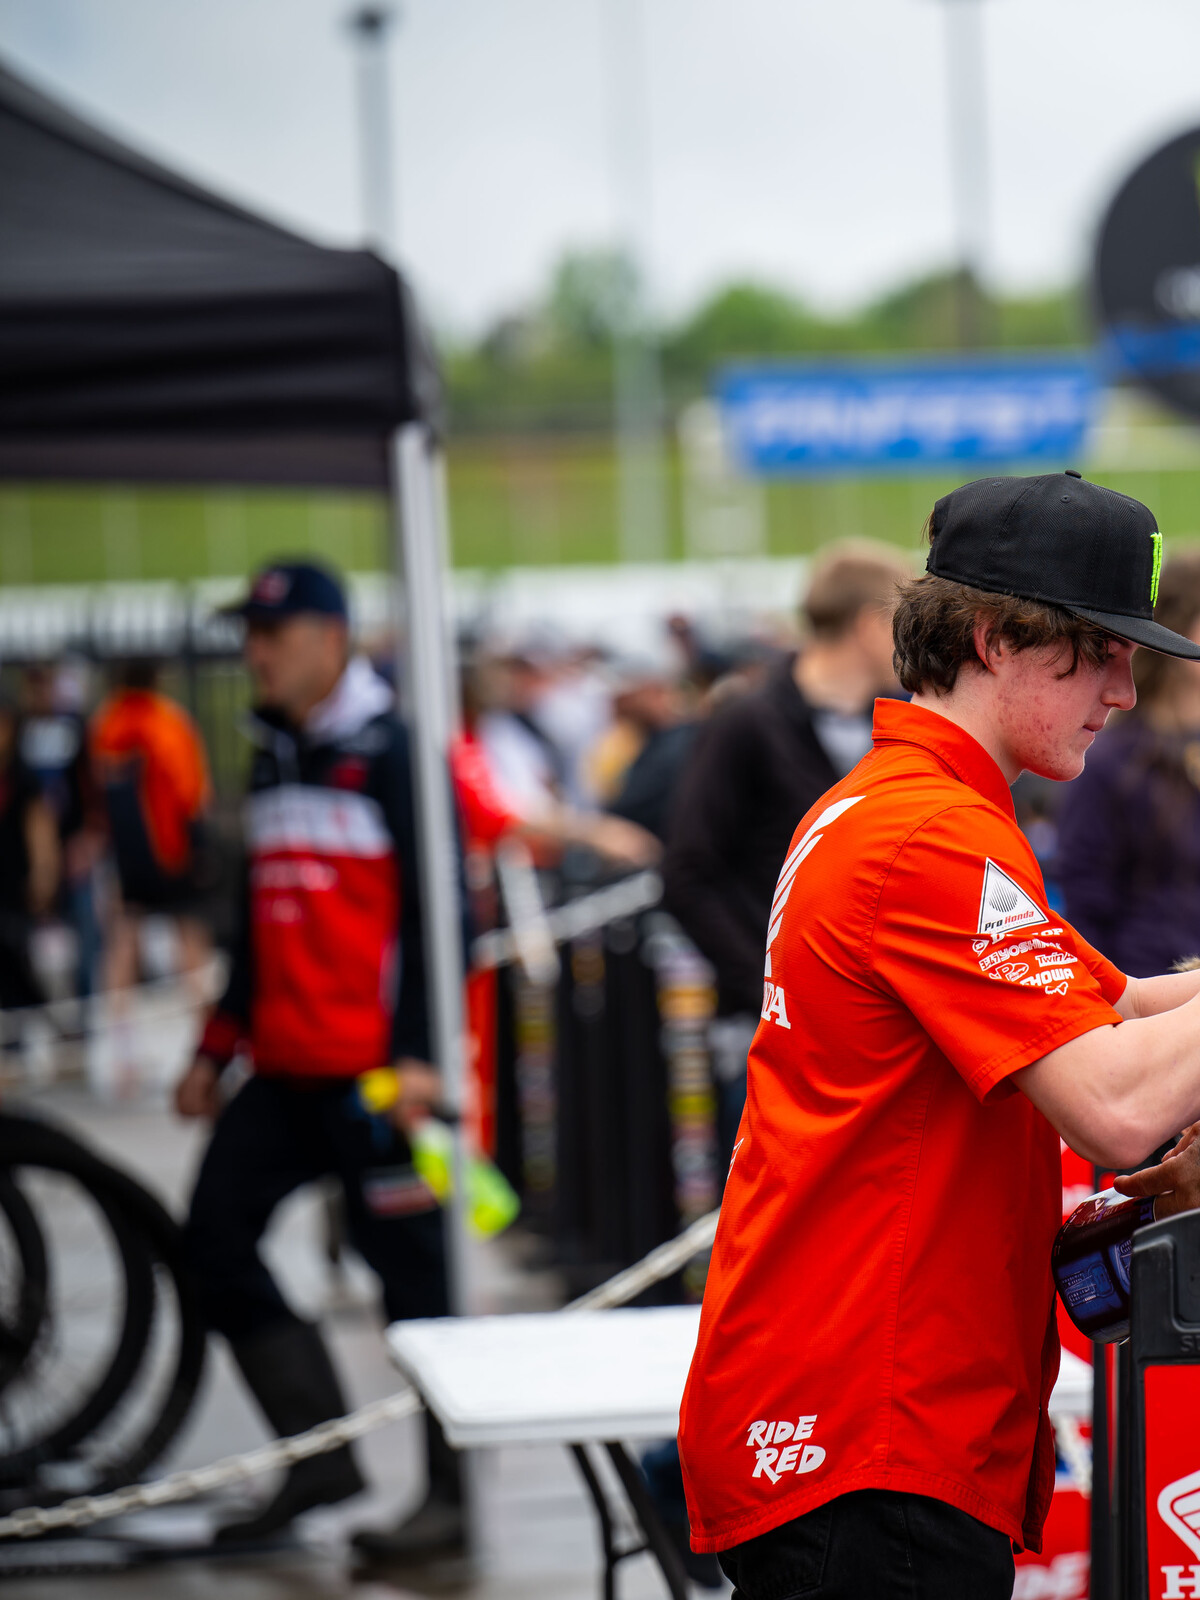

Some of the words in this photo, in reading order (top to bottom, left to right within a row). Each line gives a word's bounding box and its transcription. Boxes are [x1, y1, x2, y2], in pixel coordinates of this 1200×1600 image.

[984, 919, 1003, 931] Pro
[1004, 910, 1034, 925] Honda
[991, 928, 1064, 945] DOP
[746, 1414, 818, 1449] RIDE
[751, 1443, 826, 1485] RED
